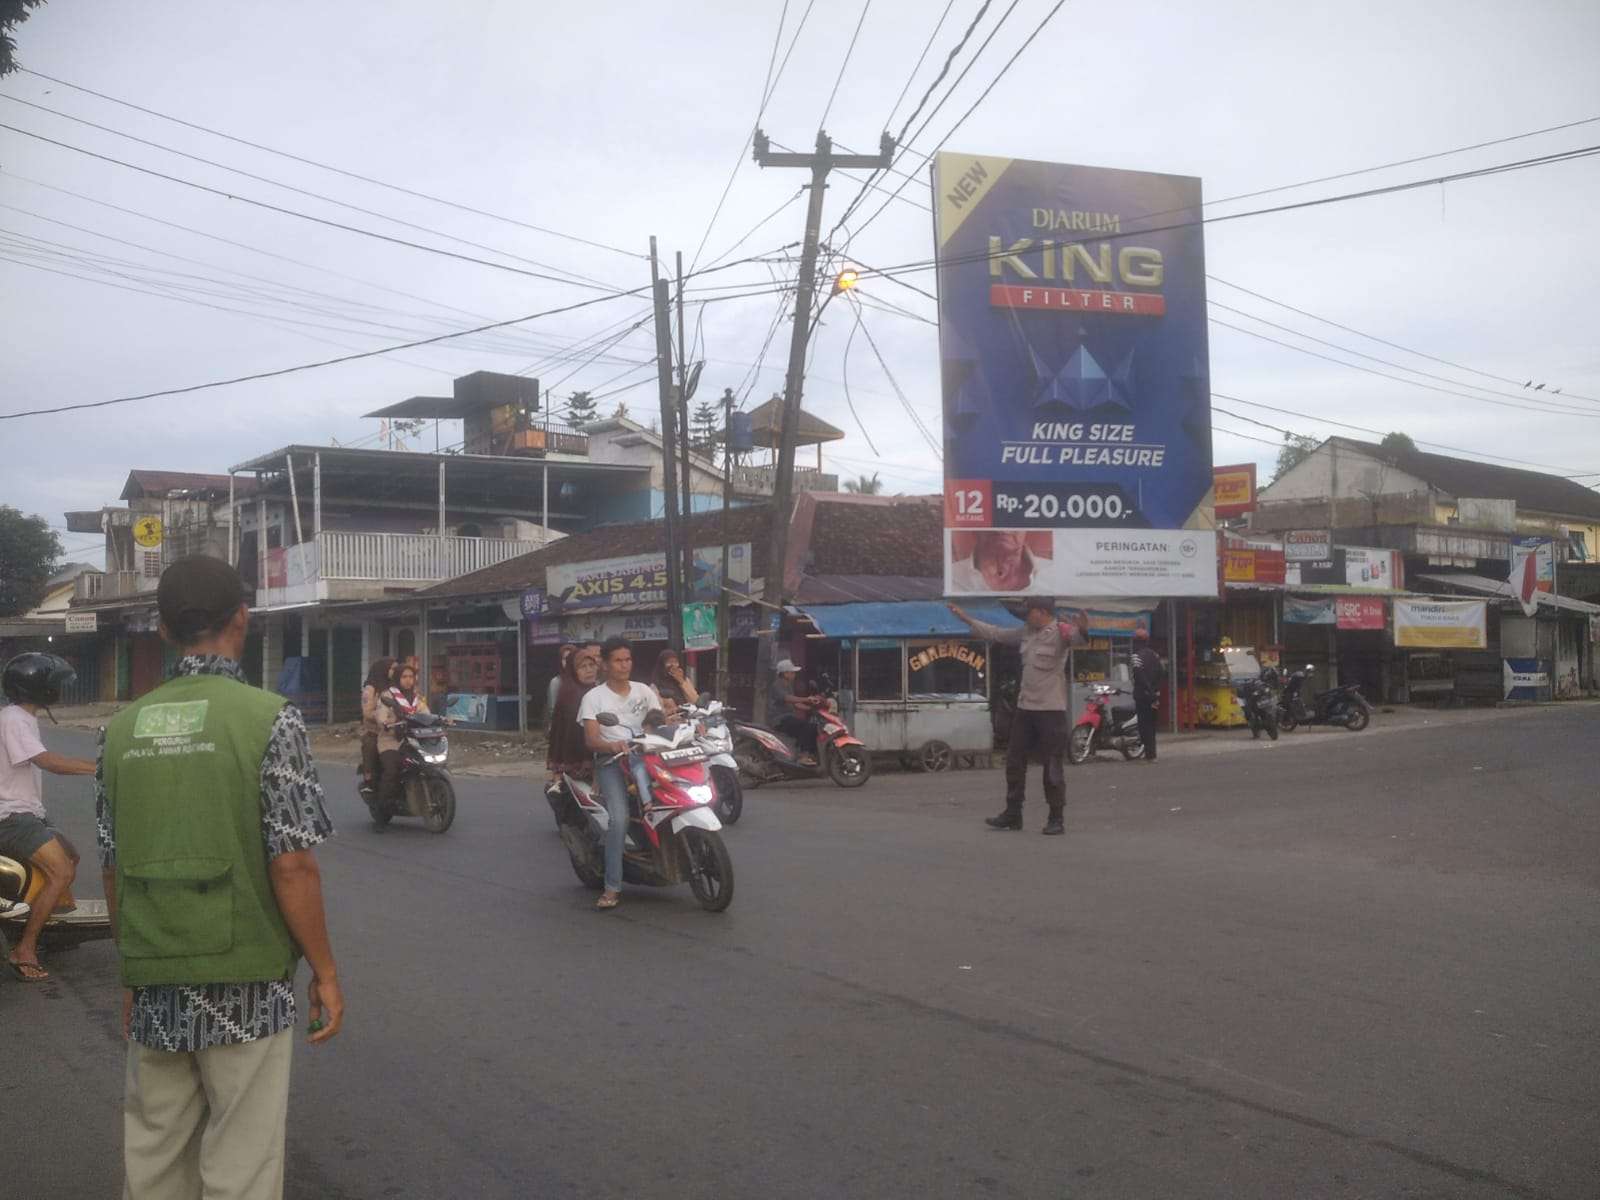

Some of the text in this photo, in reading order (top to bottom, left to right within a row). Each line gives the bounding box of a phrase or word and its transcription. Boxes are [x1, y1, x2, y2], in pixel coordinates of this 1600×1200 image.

[946, 161, 988, 209] NEW
[1032, 208, 1121, 233] DJARUM
[988, 236, 1164, 286] KING
[1023, 290, 1135, 309] FILTER
[1032, 422, 1136, 442] KING SIZE
[1001, 446, 1165, 467] FULL PLEASURE
[954, 490, 984, 514] 12
[572, 578, 624, 598] AXIS
